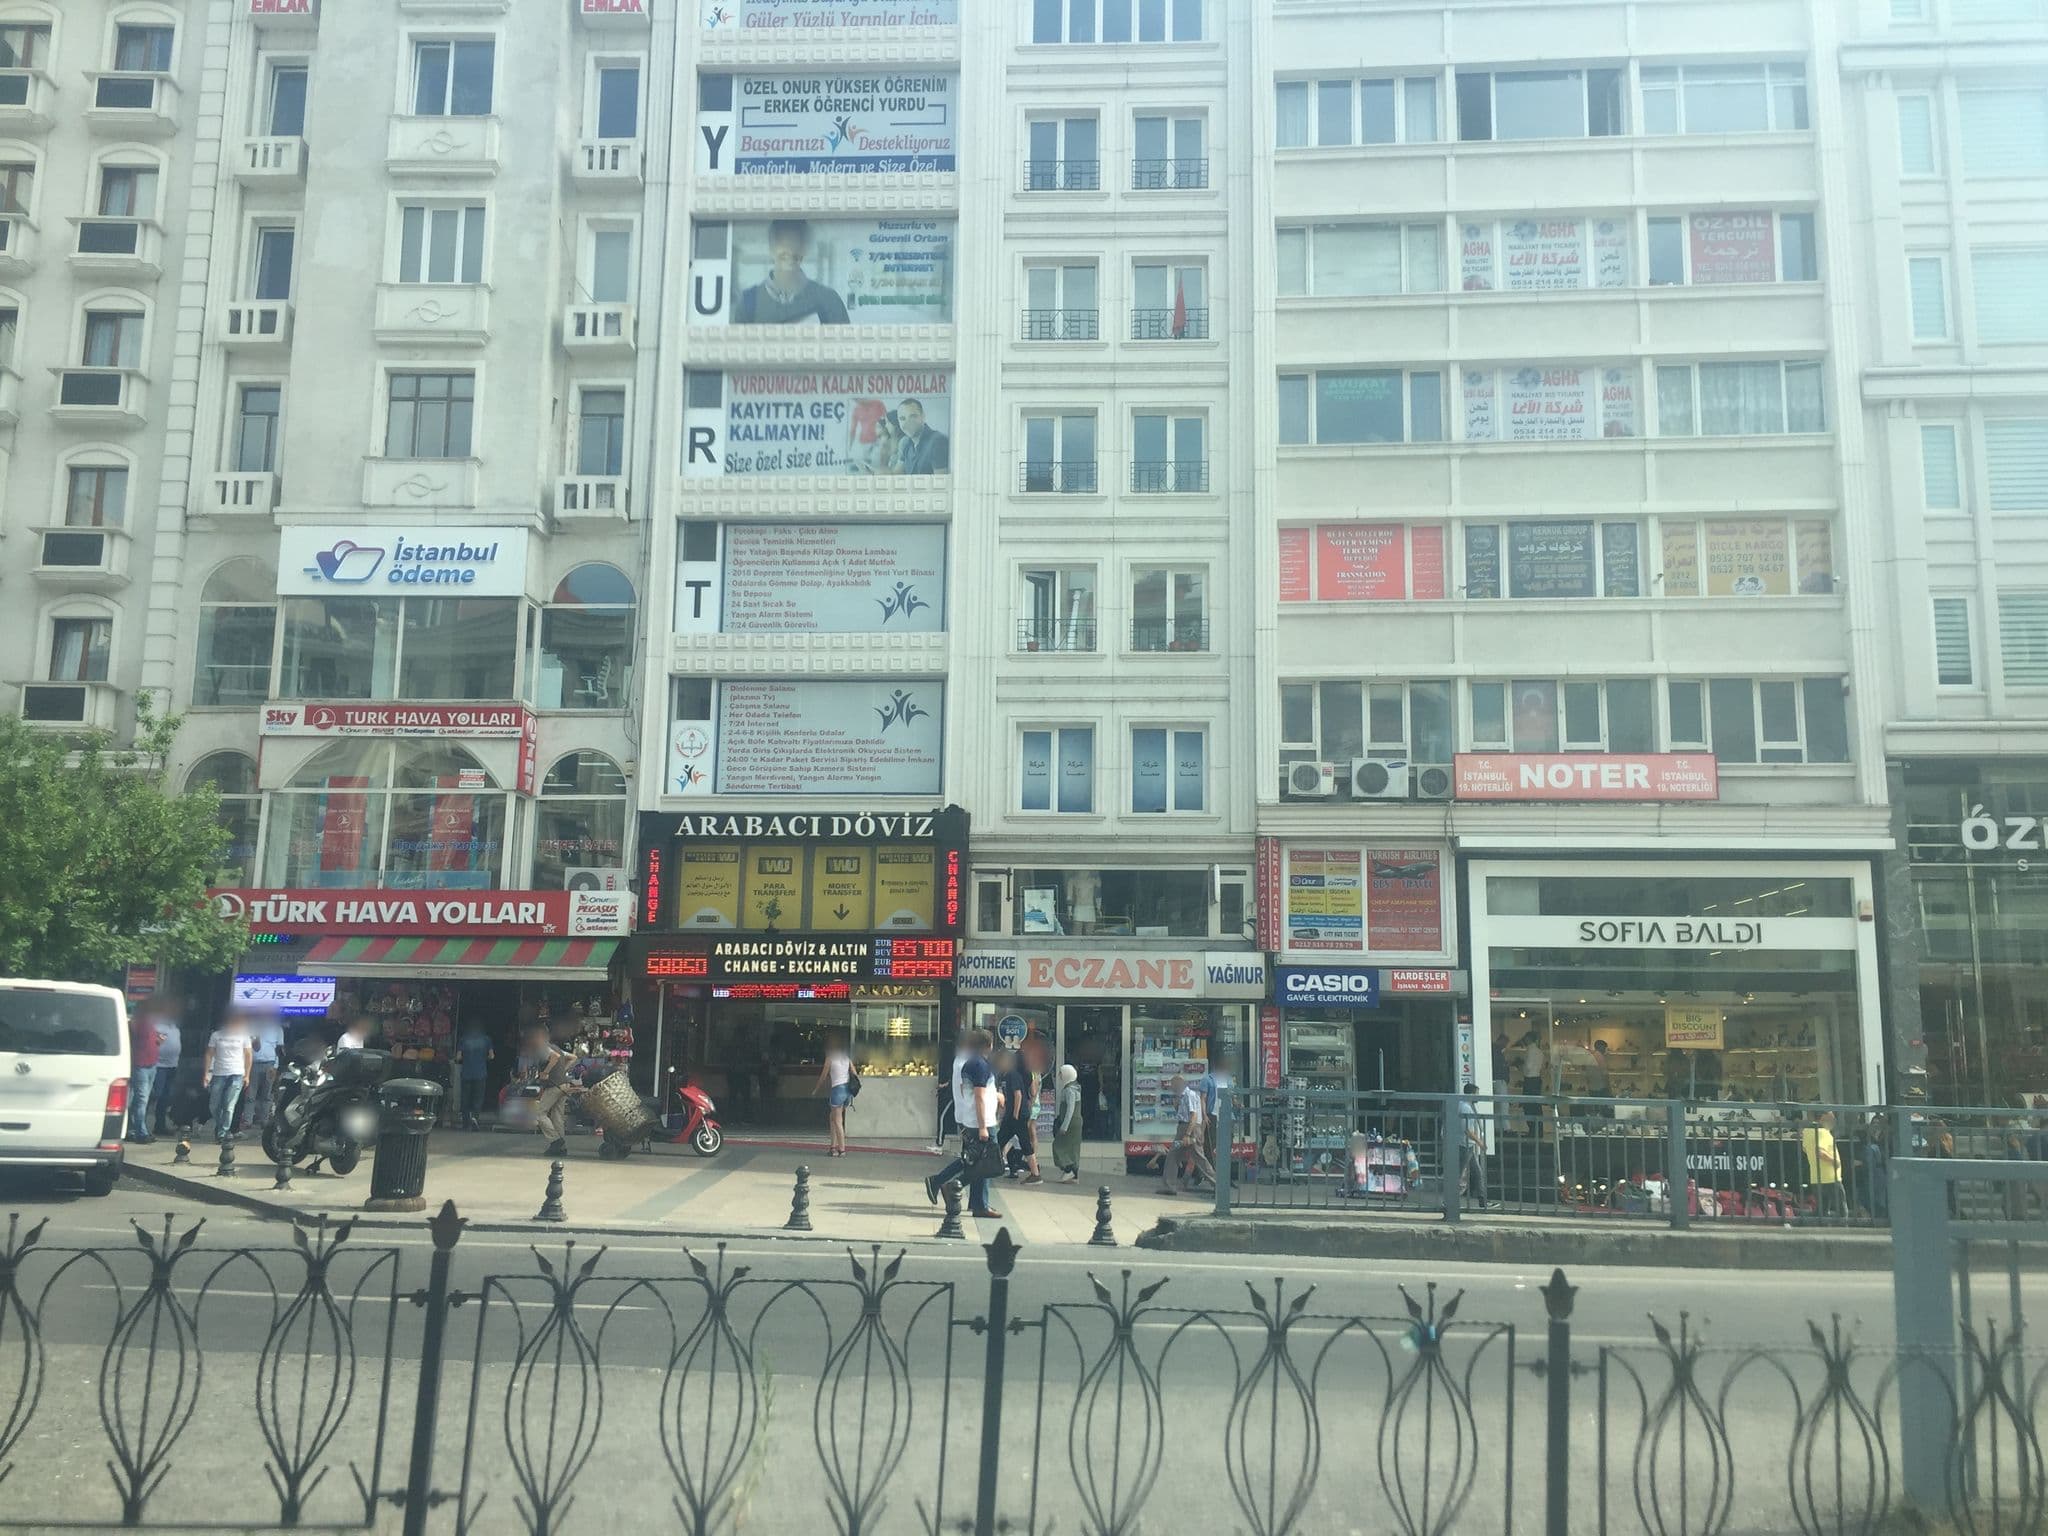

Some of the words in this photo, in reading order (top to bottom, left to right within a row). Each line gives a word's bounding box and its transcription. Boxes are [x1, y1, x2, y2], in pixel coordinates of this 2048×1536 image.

[746, 12, 787, 28] Güler
[793, 11, 835, 27] Yüzlü
[841, 10, 904, 26] Yarınlar
[744, 78, 777, 95] ÖZEL
[783, 79, 820, 94] ONUR
[826, 77, 880, 93] YÜKSEK
[885, 75, 947, 92] ÖĞRENİM
[764, 98, 809, 113] ERKEK
[814, 95, 874, 112] ÖĞRENCİ
[879, 98, 925, 112] YURDU
[741, 136, 825, 155] Başarınızı
[859, 135, 951, 154] Destekliyoruz
[809, 159, 856, 174] Modern
[861, 163, 875, 173] ve
[878, 159, 906, 172] Size
[869, 234, 911, 243] Güvenli
[913, 234, 948, 243] Ortam
[732, 376, 818, 394] YURDUMUZDA
[822, 376, 864, 394] KALAN
[868, 375, 893, 394] SON
[896, 375, 947, 394] ODALAR
[731, 402, 804, 419] KAYITTA
[810, 402, 846, 423] GEÇ
[730, 424, 825, 441] KALMAYIN!
[725, 452, 752, 474] Size
[757, 450, 783, 473] özel
[787, 447, 812, 468] size
[388, 564, 475, 584] ödeme
[743, 591, 772, 599] Deposu
[266, 709, 298, 726] Sky
[395, 712, 442, 725] HAVA
[447, 712, 516, 726] YOLLARI
[1464, 770, 1507, 782] İSTANBUL
[1519, 763, 1650, 789] NOTER
[1661, 770, 1706, 782] İSTANBUL
[675, 815, 822, 836] ARABACI
[831, 811, 934, 837] DÖVİZ
[1368, 850, 1400, 860] TURKISH
[1403, 850, 1438, 860] AIRLINES
[648, 848, 660, 923] CHANGE
[947, 850, 959, 925] CHANGE
[250, 894, 327, 925] TÜRK
[336, 901, 419, 925] HAVA
[420, 901, 545, 925] YOLLARI
[576, 904, 619, 913] PEGASUS
[1579, 921, 1666, 943] SOFIA
[1676, 922, 1762, 944] BALDI
[715, 942, 772, 956] ARABACI
[775, 940, 817, 956] DÖVİZ
[818, 943, 827, 955] &
[830, 942, 867, 956] ALTIN
[875, 939, 892, 947] EUR
[875, 948, 892, 957] BUY
[724, 960, 777, 973] CHANGE
[788, 960, 858, 974] EXCHANGE
[959, 956, 1015, 970] APOTHEKE
[873, 967, 892, 976] SELL
[1027, 957, 1194, 990] ECZANE
[1207, 963, 1264, 986] YAĞMUR
[1393, 971, 1447, 982] KARDEŞLER
[855, 983, 935, 997] ARABACI
[958, 975, 1015, 990] PHARMACY
[1286, 974, 1369, 993] CASIO
[271, 990, 330, 1003] ist-pay
[798, 989, 815, 998] EUR
[1286, 994, 1315, 1002] GAVES
[1317, 993, 1368, 1002] ELEKTRONİK
[1672, 1023, 1716, 1031] DISCOUNT
